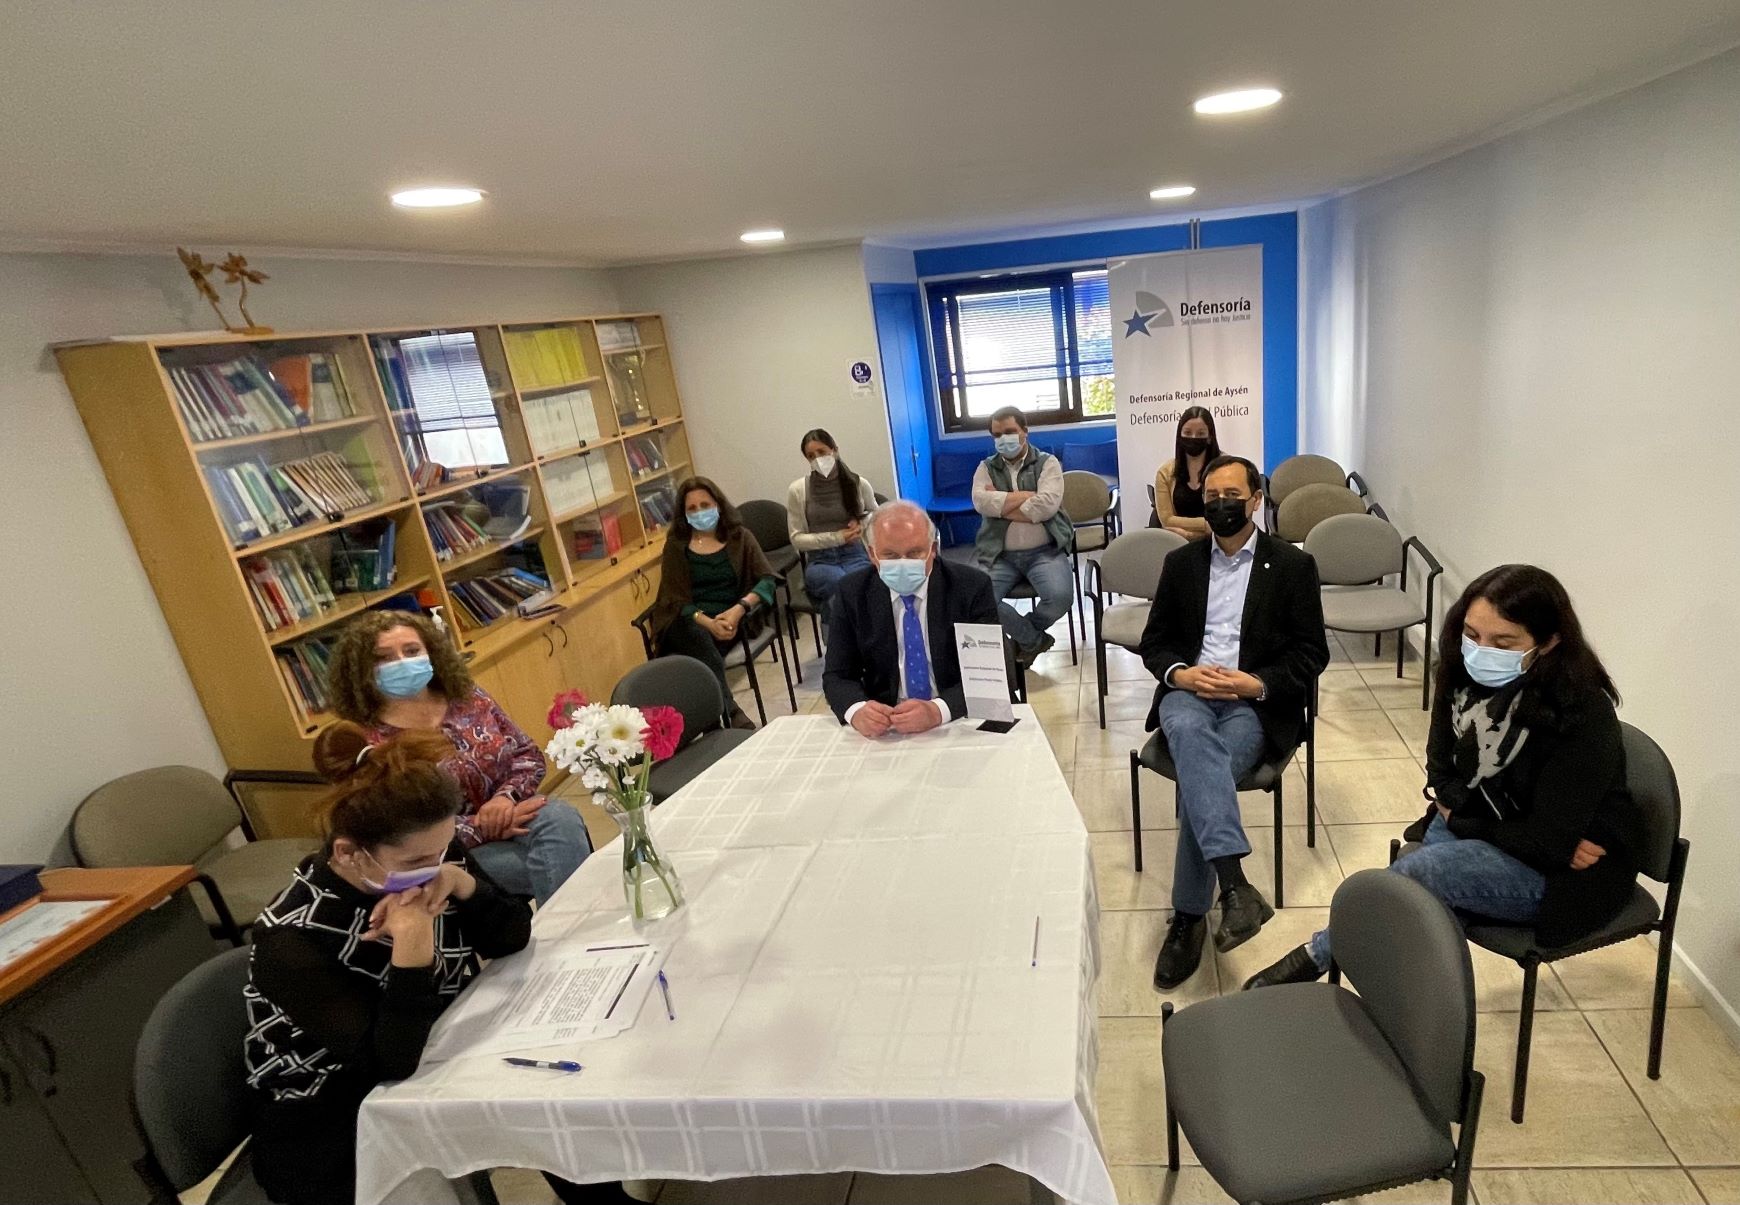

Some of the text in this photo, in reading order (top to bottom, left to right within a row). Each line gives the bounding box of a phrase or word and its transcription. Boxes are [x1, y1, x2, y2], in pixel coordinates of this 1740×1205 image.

[1180, 297, 1251, 317] Defensoría
[1129, 385, 1249, 404] Defensoría Regional de Aysén
[1130, 410, 1182, 426] Defensoría
[1214, 405, 1249, 418] Pública
